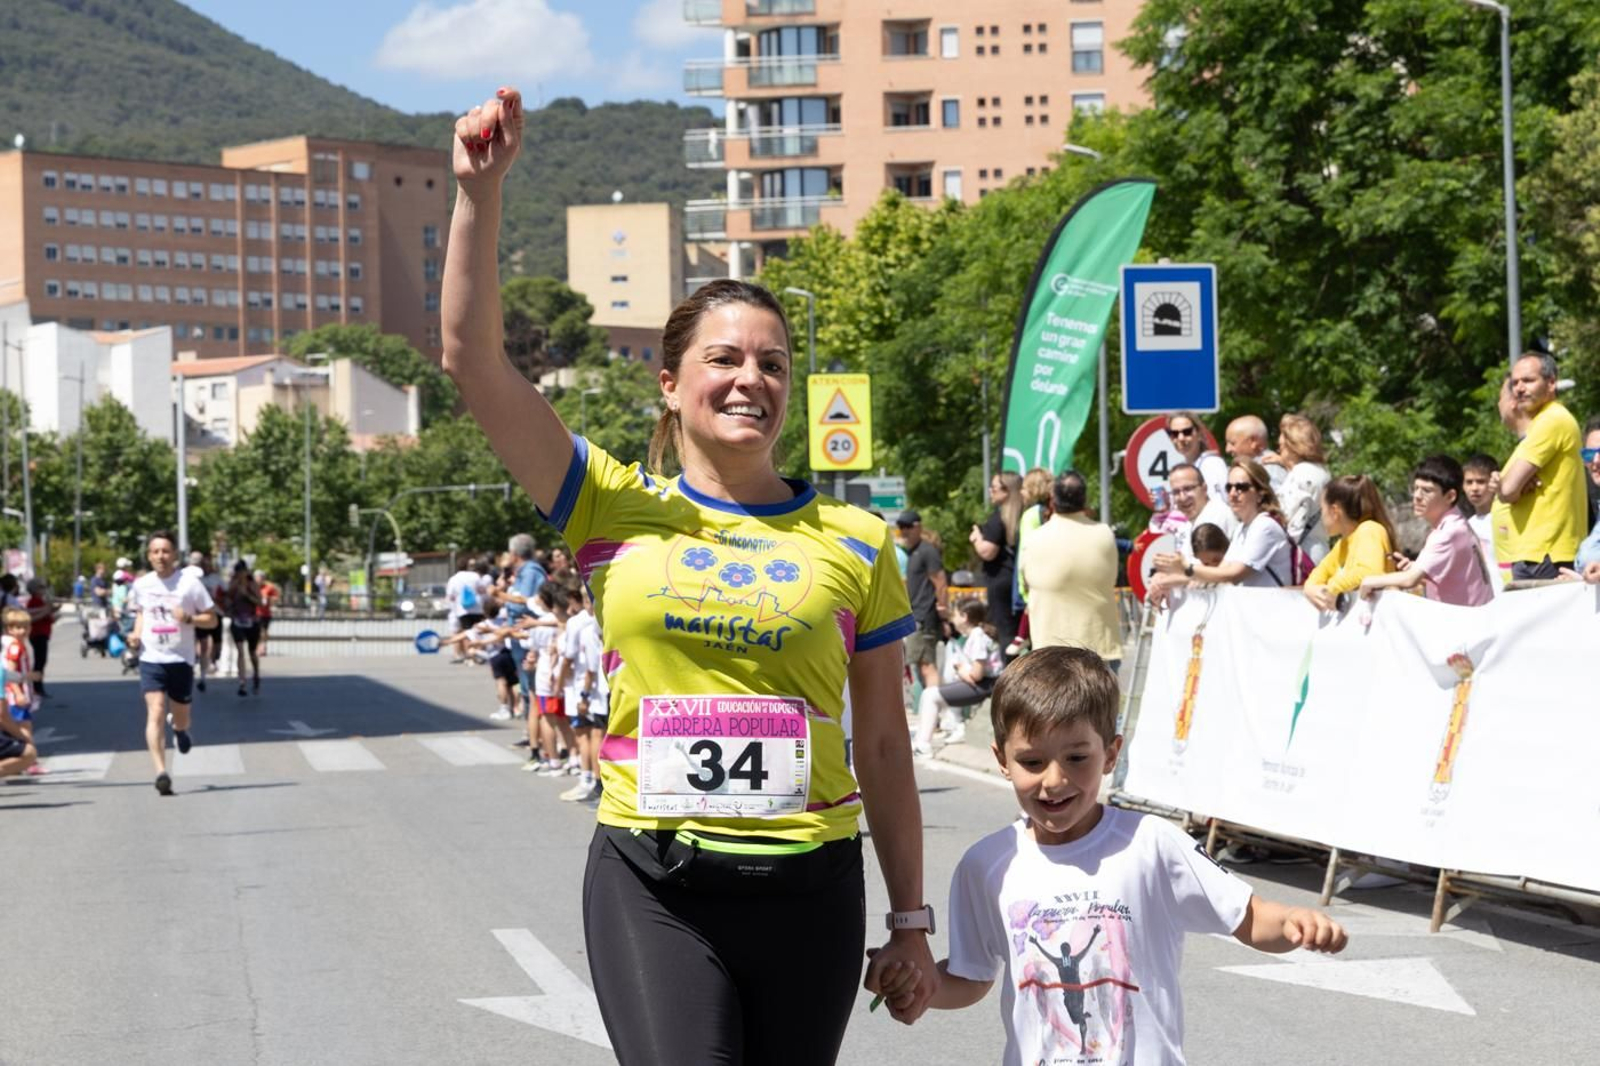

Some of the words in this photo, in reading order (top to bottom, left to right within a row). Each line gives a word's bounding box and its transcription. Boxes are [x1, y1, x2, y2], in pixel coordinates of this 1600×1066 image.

[1041, 330, 1058, 342] un
[1037, 347, 1079, 364] camino
[1033, 363, 1054, 376] por
[1030, 378, 1068, 396] delante
[831, 440, 851, 451] 20
[665, 613, 791, 651] maristas
[650, 699, 712, 716] XXVII
[717, 701, 761, 713] EDUCACIÓN
[650, 717, 724, 736] CARRERA
[729, 717, 800, 736] POPULAR
[687, 739, 768, 792] 34
[1087, 899, 1131, 915] Popular
